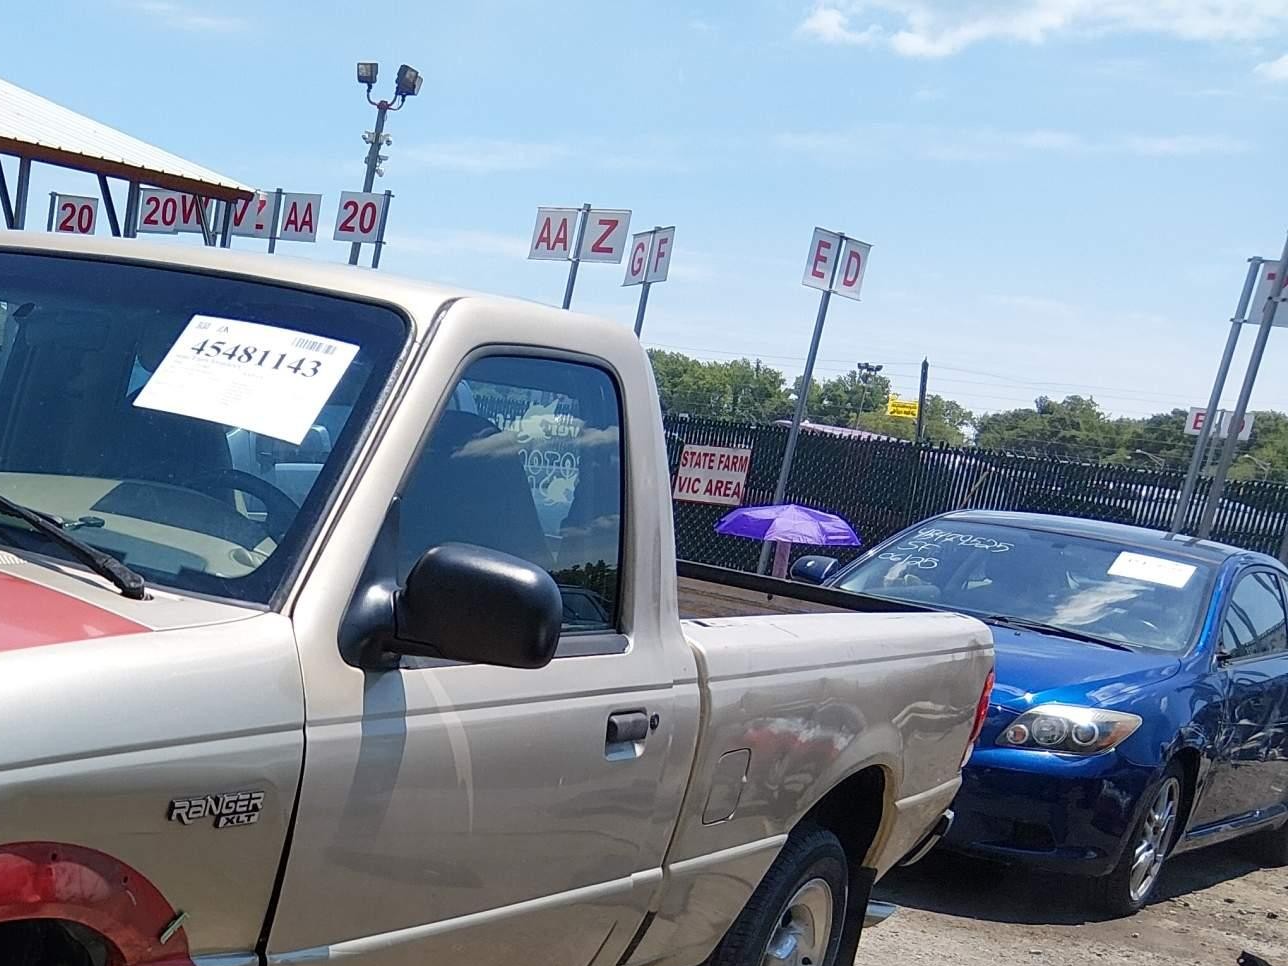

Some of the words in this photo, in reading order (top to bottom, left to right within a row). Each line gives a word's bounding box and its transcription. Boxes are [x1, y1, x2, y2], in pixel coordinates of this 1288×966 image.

[59, 203, 93, 234] 20
[143, 196, 177, 226] 20
[283, 201, 313, 233] AA
[338, 200, 377, 234] 20
[535, 217, 568, 251] AA
[591, 219, 619, 253] Z
[631, 242, 645, 276] G
[654, 238, 668, 273] F
[812, 240, 832, 279] E
[843, 250, 861, 287] D
[191, 338, 322, 378] 45481143
[681, 450, 715, 470] STATE
[717, 453, 748, 473] FARM
[678, 476, 701, 494] VIC
[703, 479, 740, 499] AREA
[169, 791, 264, 825] RANGER
[222, 813, 257, 826] XLT
